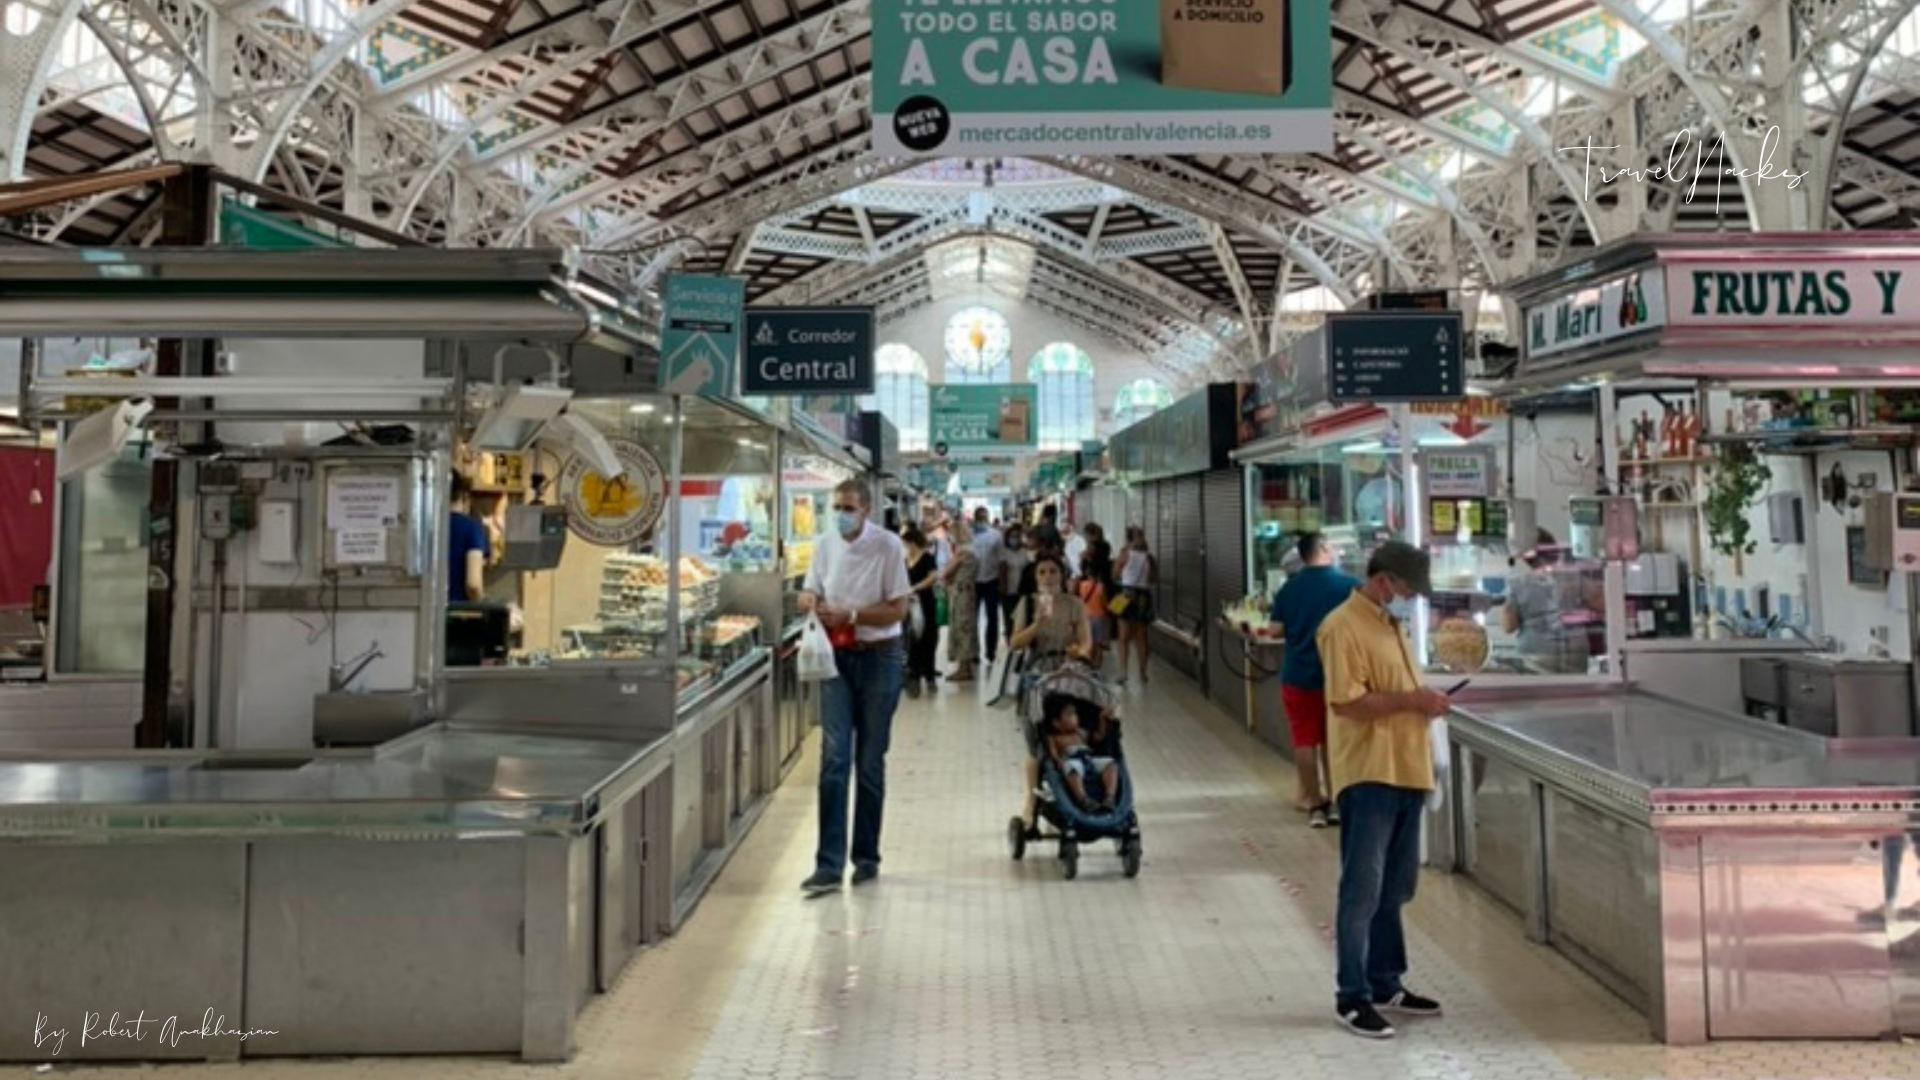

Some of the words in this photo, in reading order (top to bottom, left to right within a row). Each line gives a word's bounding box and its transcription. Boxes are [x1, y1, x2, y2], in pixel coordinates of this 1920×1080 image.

[901, 11, 977, 33] TODO
[988, 11, 1016, 32] EL
[1028, 10, 1117, 32] SABOR
[1174, 9, 1183, 20] A
[1187, 9, 1265, 23] DOMICILIO
[900, 37, 936, 85] A
[962, 36, 1118, 85] CASA
[898, 107, 942, 127] NUEVA
[908, 122, 938, 138] WEB
[959, 121, 1271, 143] mercadocentralvalencia.es
[672, 285, 728, 301] Servicio
[1691, 270, 1852, 315] FRUTAS
[1873, 270, 1901, 315] Y
[787, 328, 857, 344] Corredor
[759, 355, 856, 381] Central
